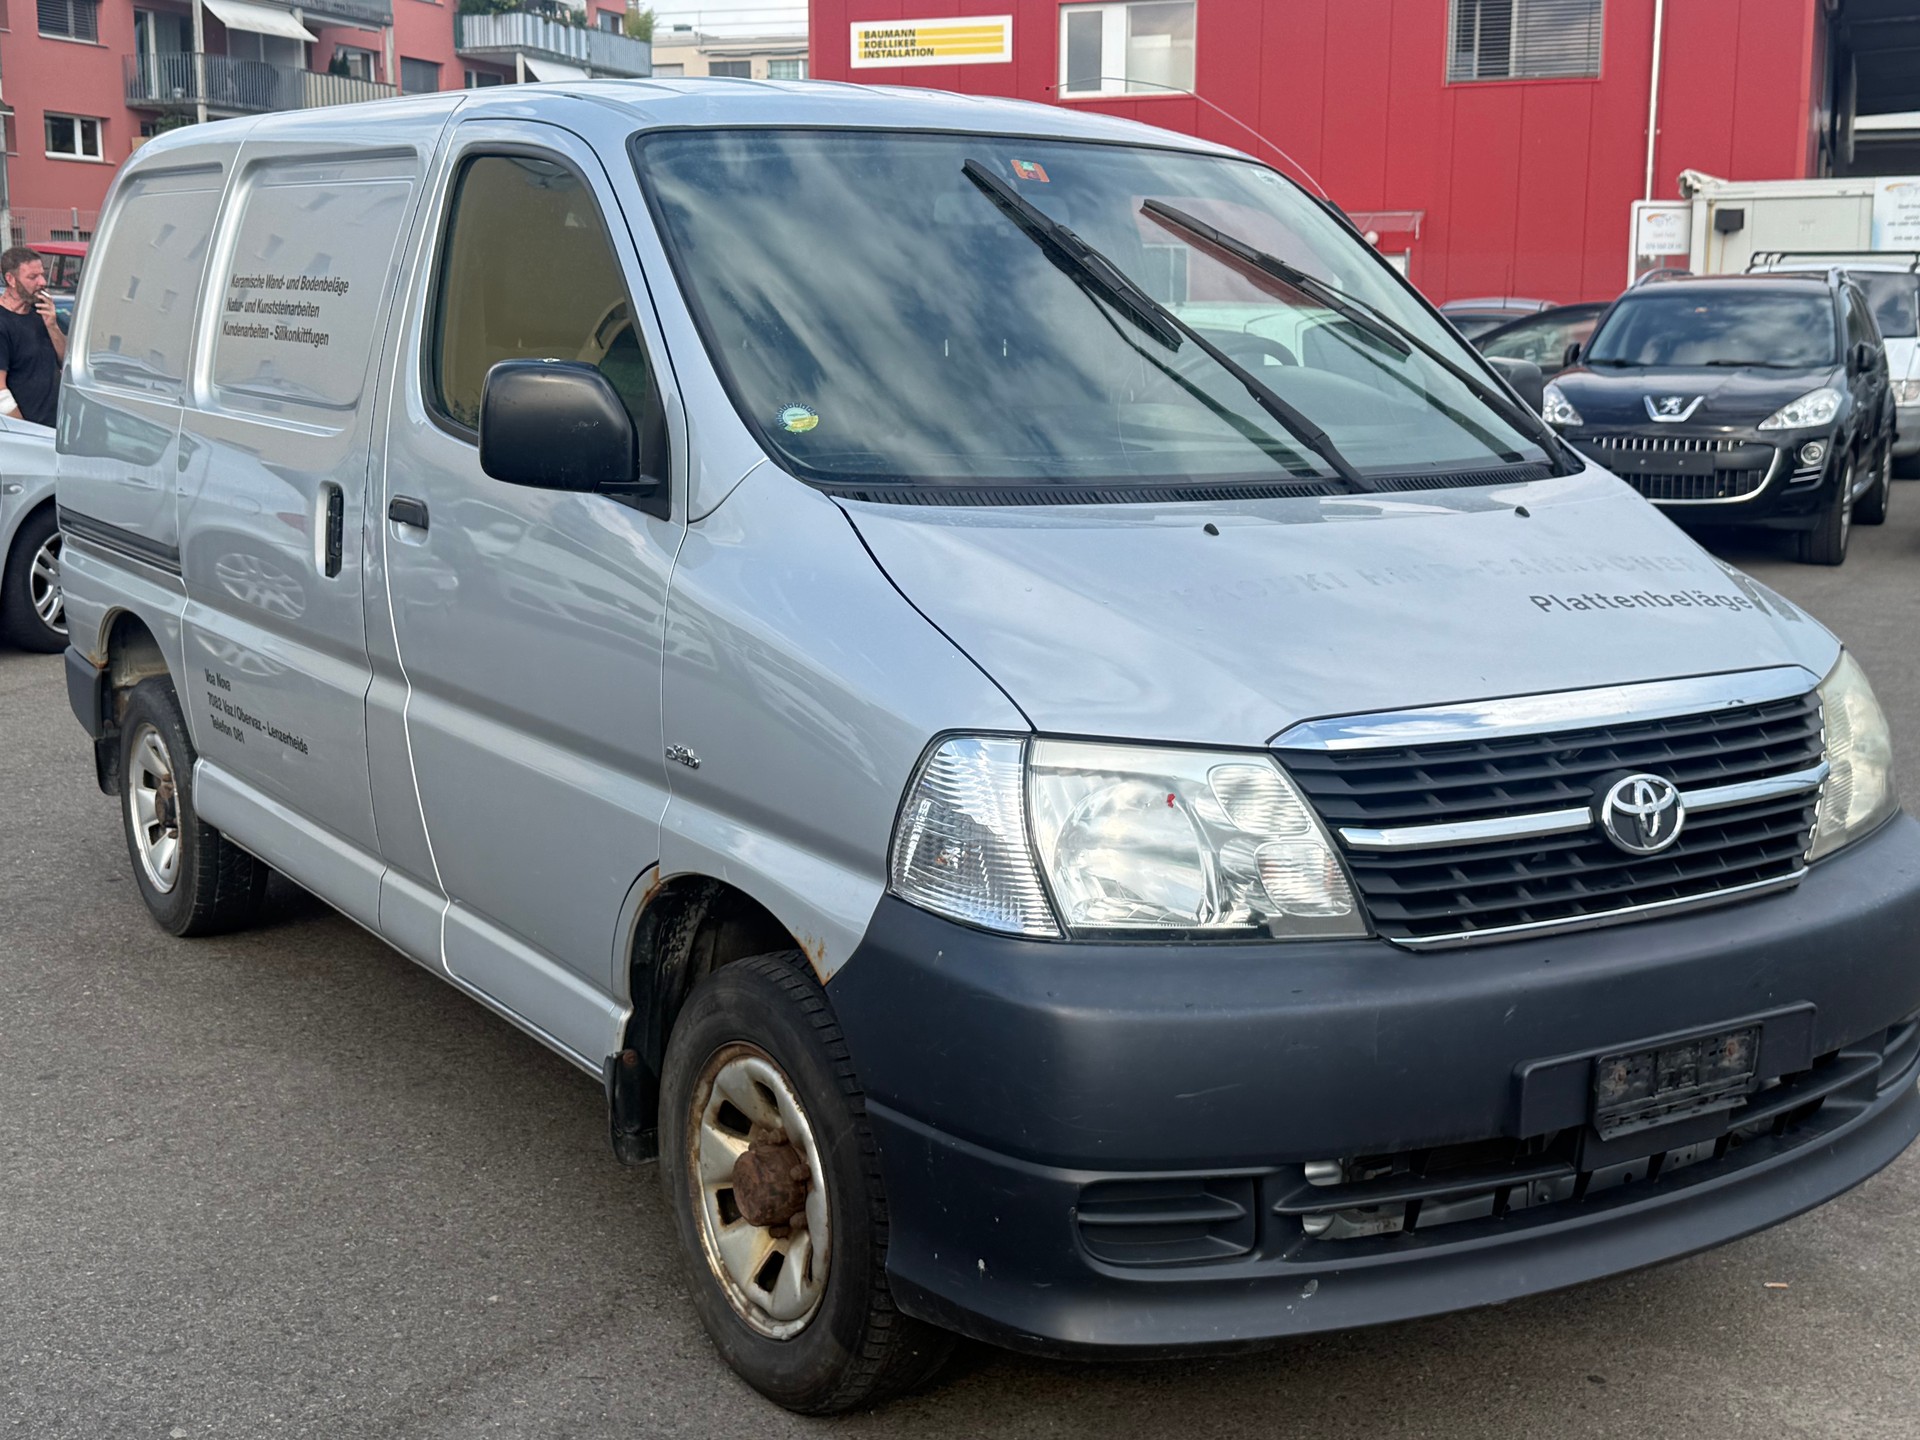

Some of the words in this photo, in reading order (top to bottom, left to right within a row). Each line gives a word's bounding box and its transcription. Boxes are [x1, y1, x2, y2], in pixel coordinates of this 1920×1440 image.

[864, 28, 916, 40] BAUMANN
[864, 38, 916, 49] KOELLIKER
[864, 48, 935, 59] INSTALLATION
[231, 273, 266, 289] Keramische
[265, 274, 286, 290] Wand-
[286, 275, 301, 291] und
[300, 275, 349, 297] Bodenbeläge
[226, 297, 244, 312] Natur-
[244, 298, 258, 313] und
[256, 298, 321, 318] Kunststeinarbeiten
[223, 321, 269, 339] Kundenarbeiten
[274, 325, 330, 348] Silikonkittfugen
[1529, 590, 1753, 613] Plattenbeläge
[210, 713, 233, 737] Telefon
[266, 720, 309, 755] Lenzerheide
